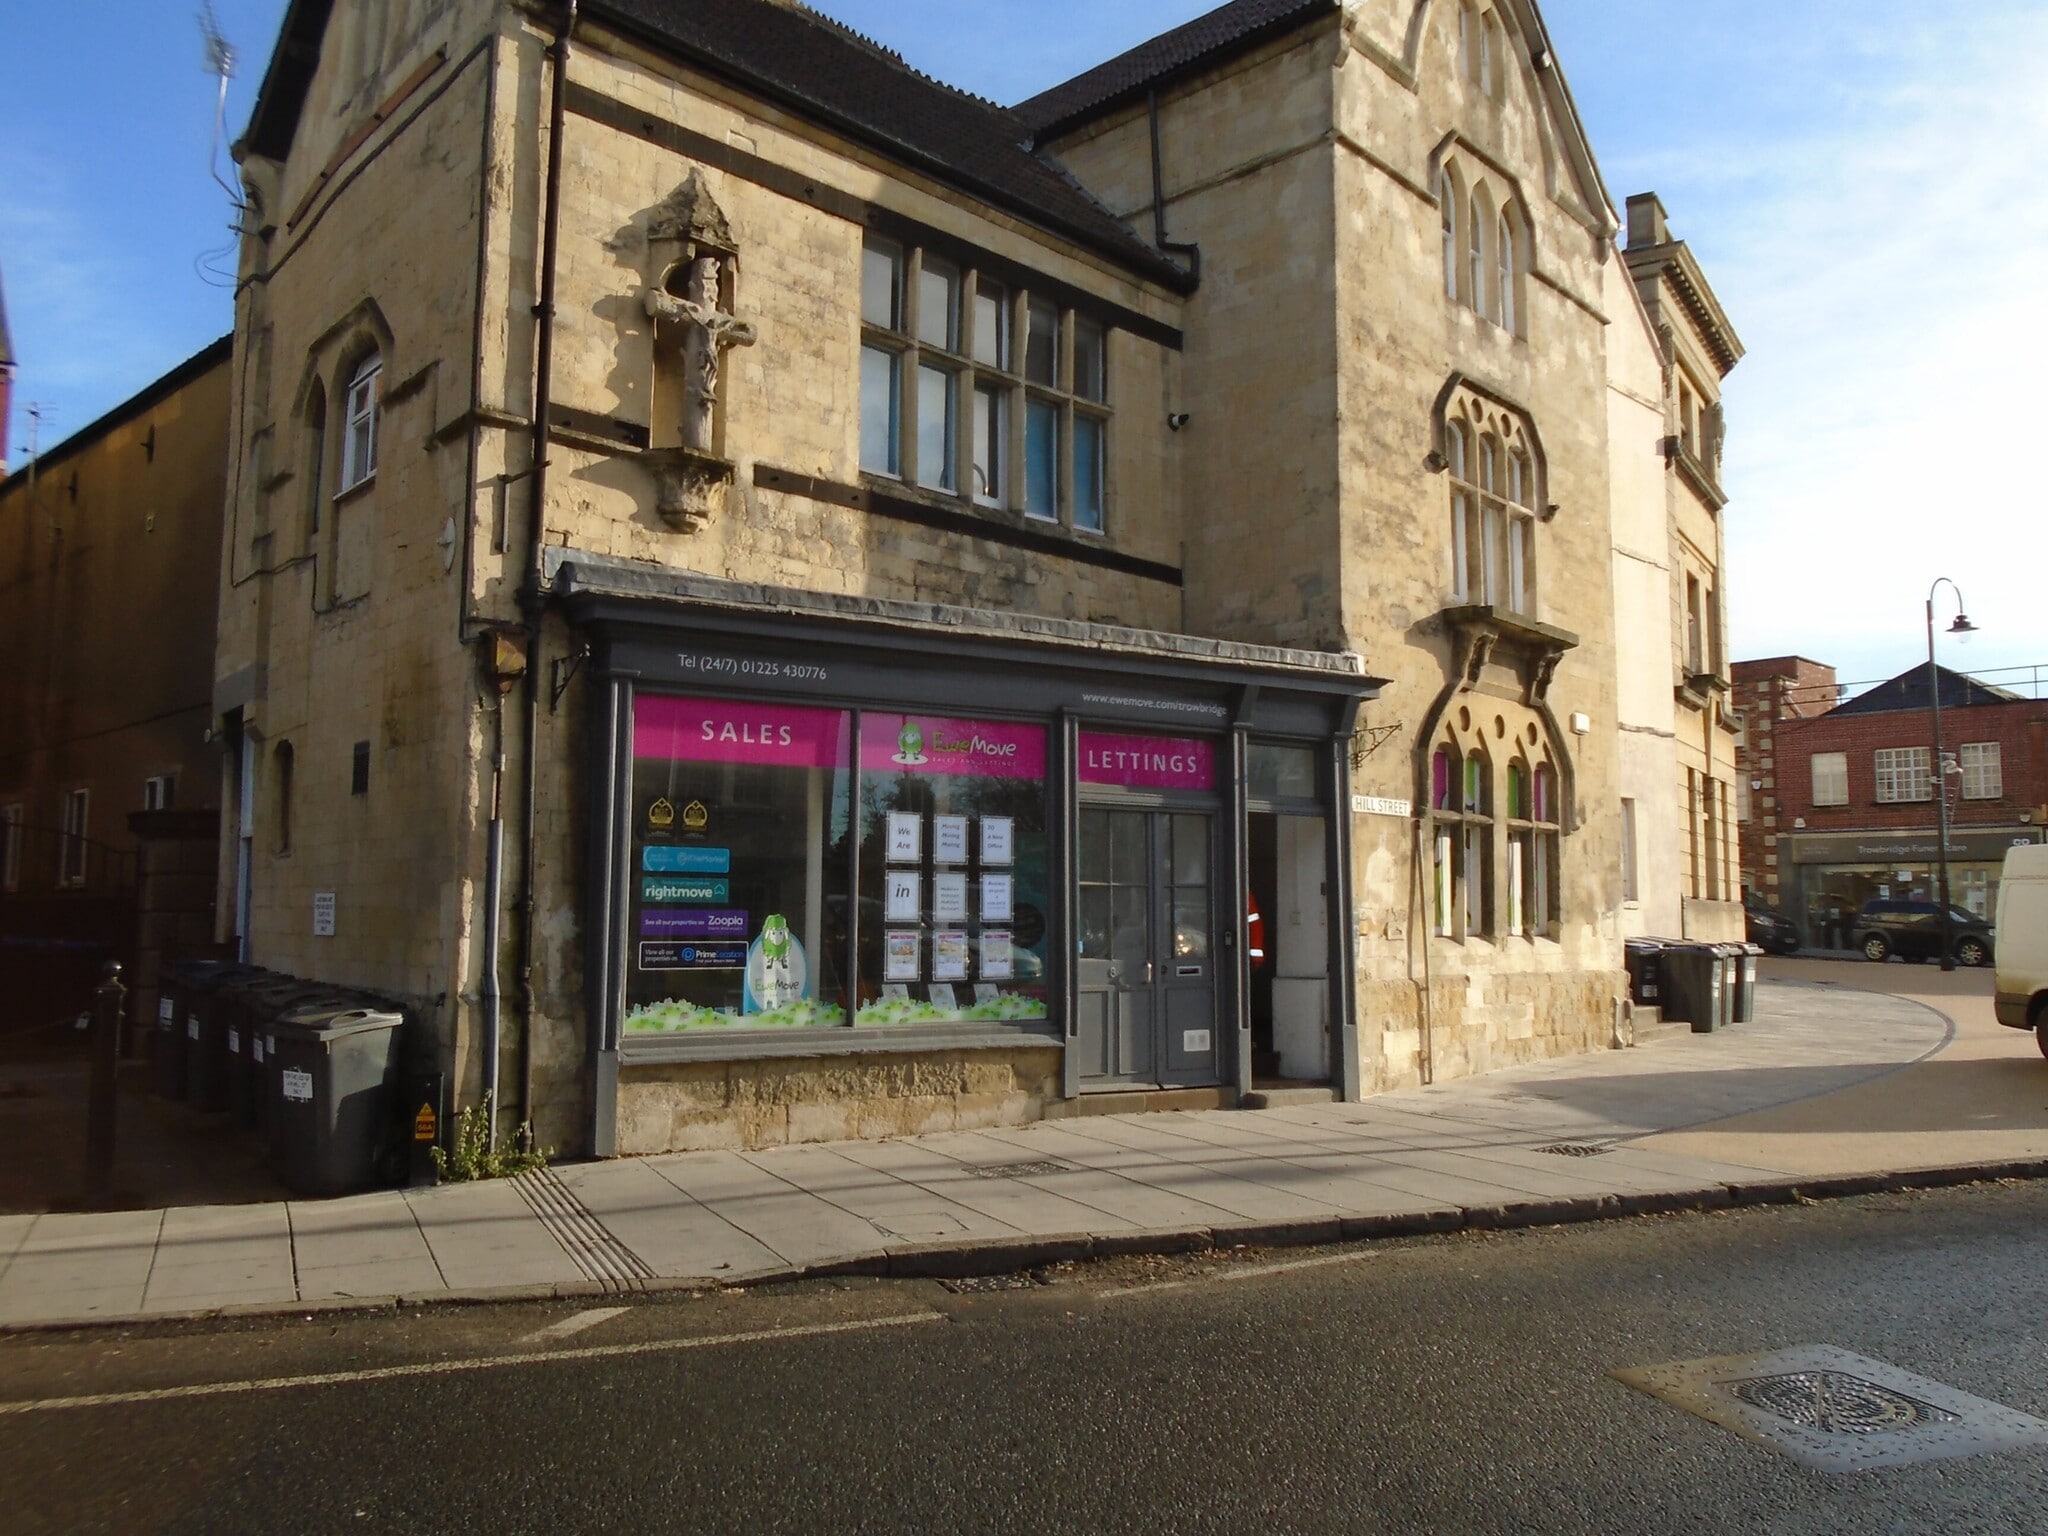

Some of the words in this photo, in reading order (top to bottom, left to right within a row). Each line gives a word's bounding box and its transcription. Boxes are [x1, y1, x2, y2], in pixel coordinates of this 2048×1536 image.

[678, 654, 696, 668] Tel
[700, 656, 738, 675] (24/7)
[741, 660, 779, 676] 01225
[783, 664, 827, 680] 430776
[1082, 693, 1228, 717] www.ewemove.com/trowbridge
[701, 720, 792, 746] SALES
[932, 731, 1017, 756] EweMove
[1088, 750, 1198, 773] LETTINGS
[1355, 797, 1376, 811] HILL
[1378, 800, 1408, 815] STREET
[898, 826, 911, 836] We
[896, 840, 911, 850] Are
[1858, 845, 1910, 855] Trowbridge
[645, 885, 713, 900] rightmove
[896, 884, 910, 898] in
[708, 915, 744, 927] Zoopla
[1110, 966, 1117, 978] 8
[754, 978, 800, 993] EweMove
